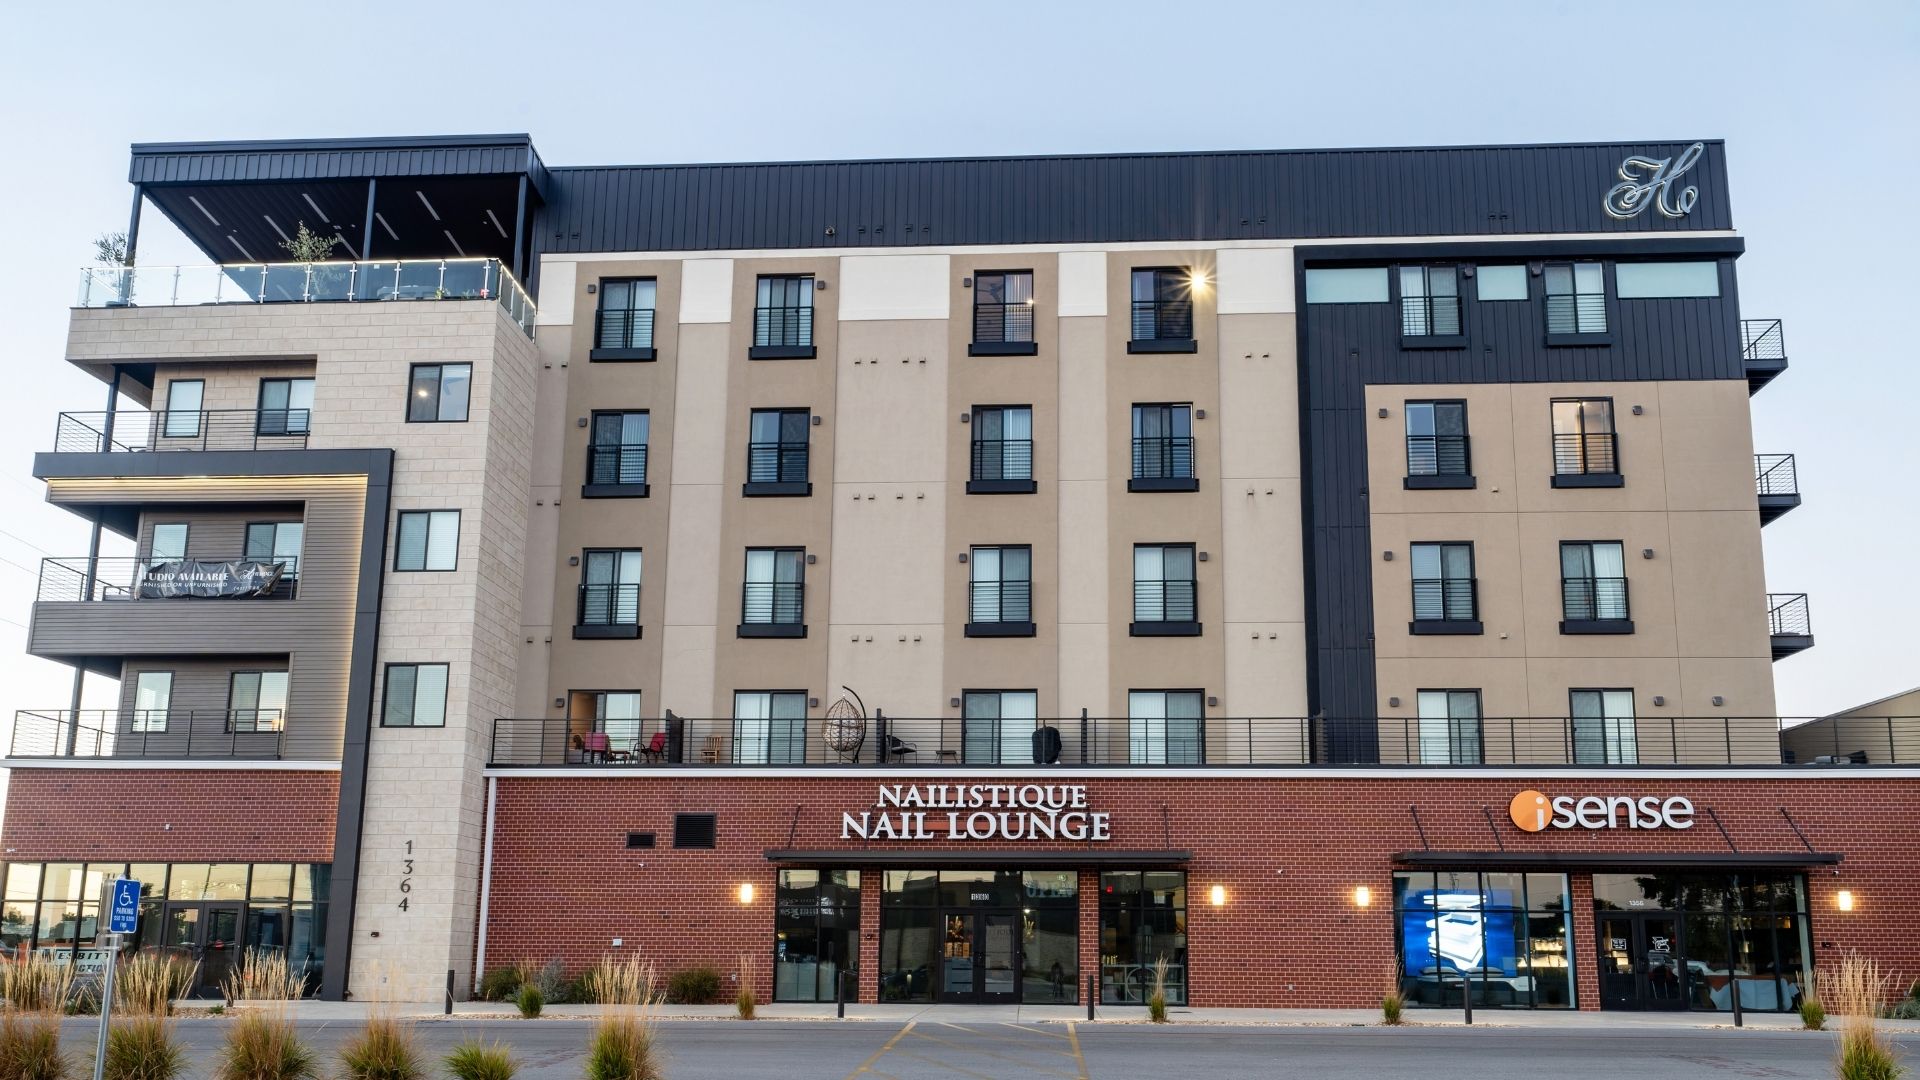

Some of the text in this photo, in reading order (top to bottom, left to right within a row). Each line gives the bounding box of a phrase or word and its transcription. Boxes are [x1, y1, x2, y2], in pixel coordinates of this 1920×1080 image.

[178, 571, 229, 581] AVAILABLE
[877, 784, 1088, 813] NAILISTIQUE
[840, 811, 1111, 841] NAIL LOUNGE
[398, 839, 414, 912] 1364
